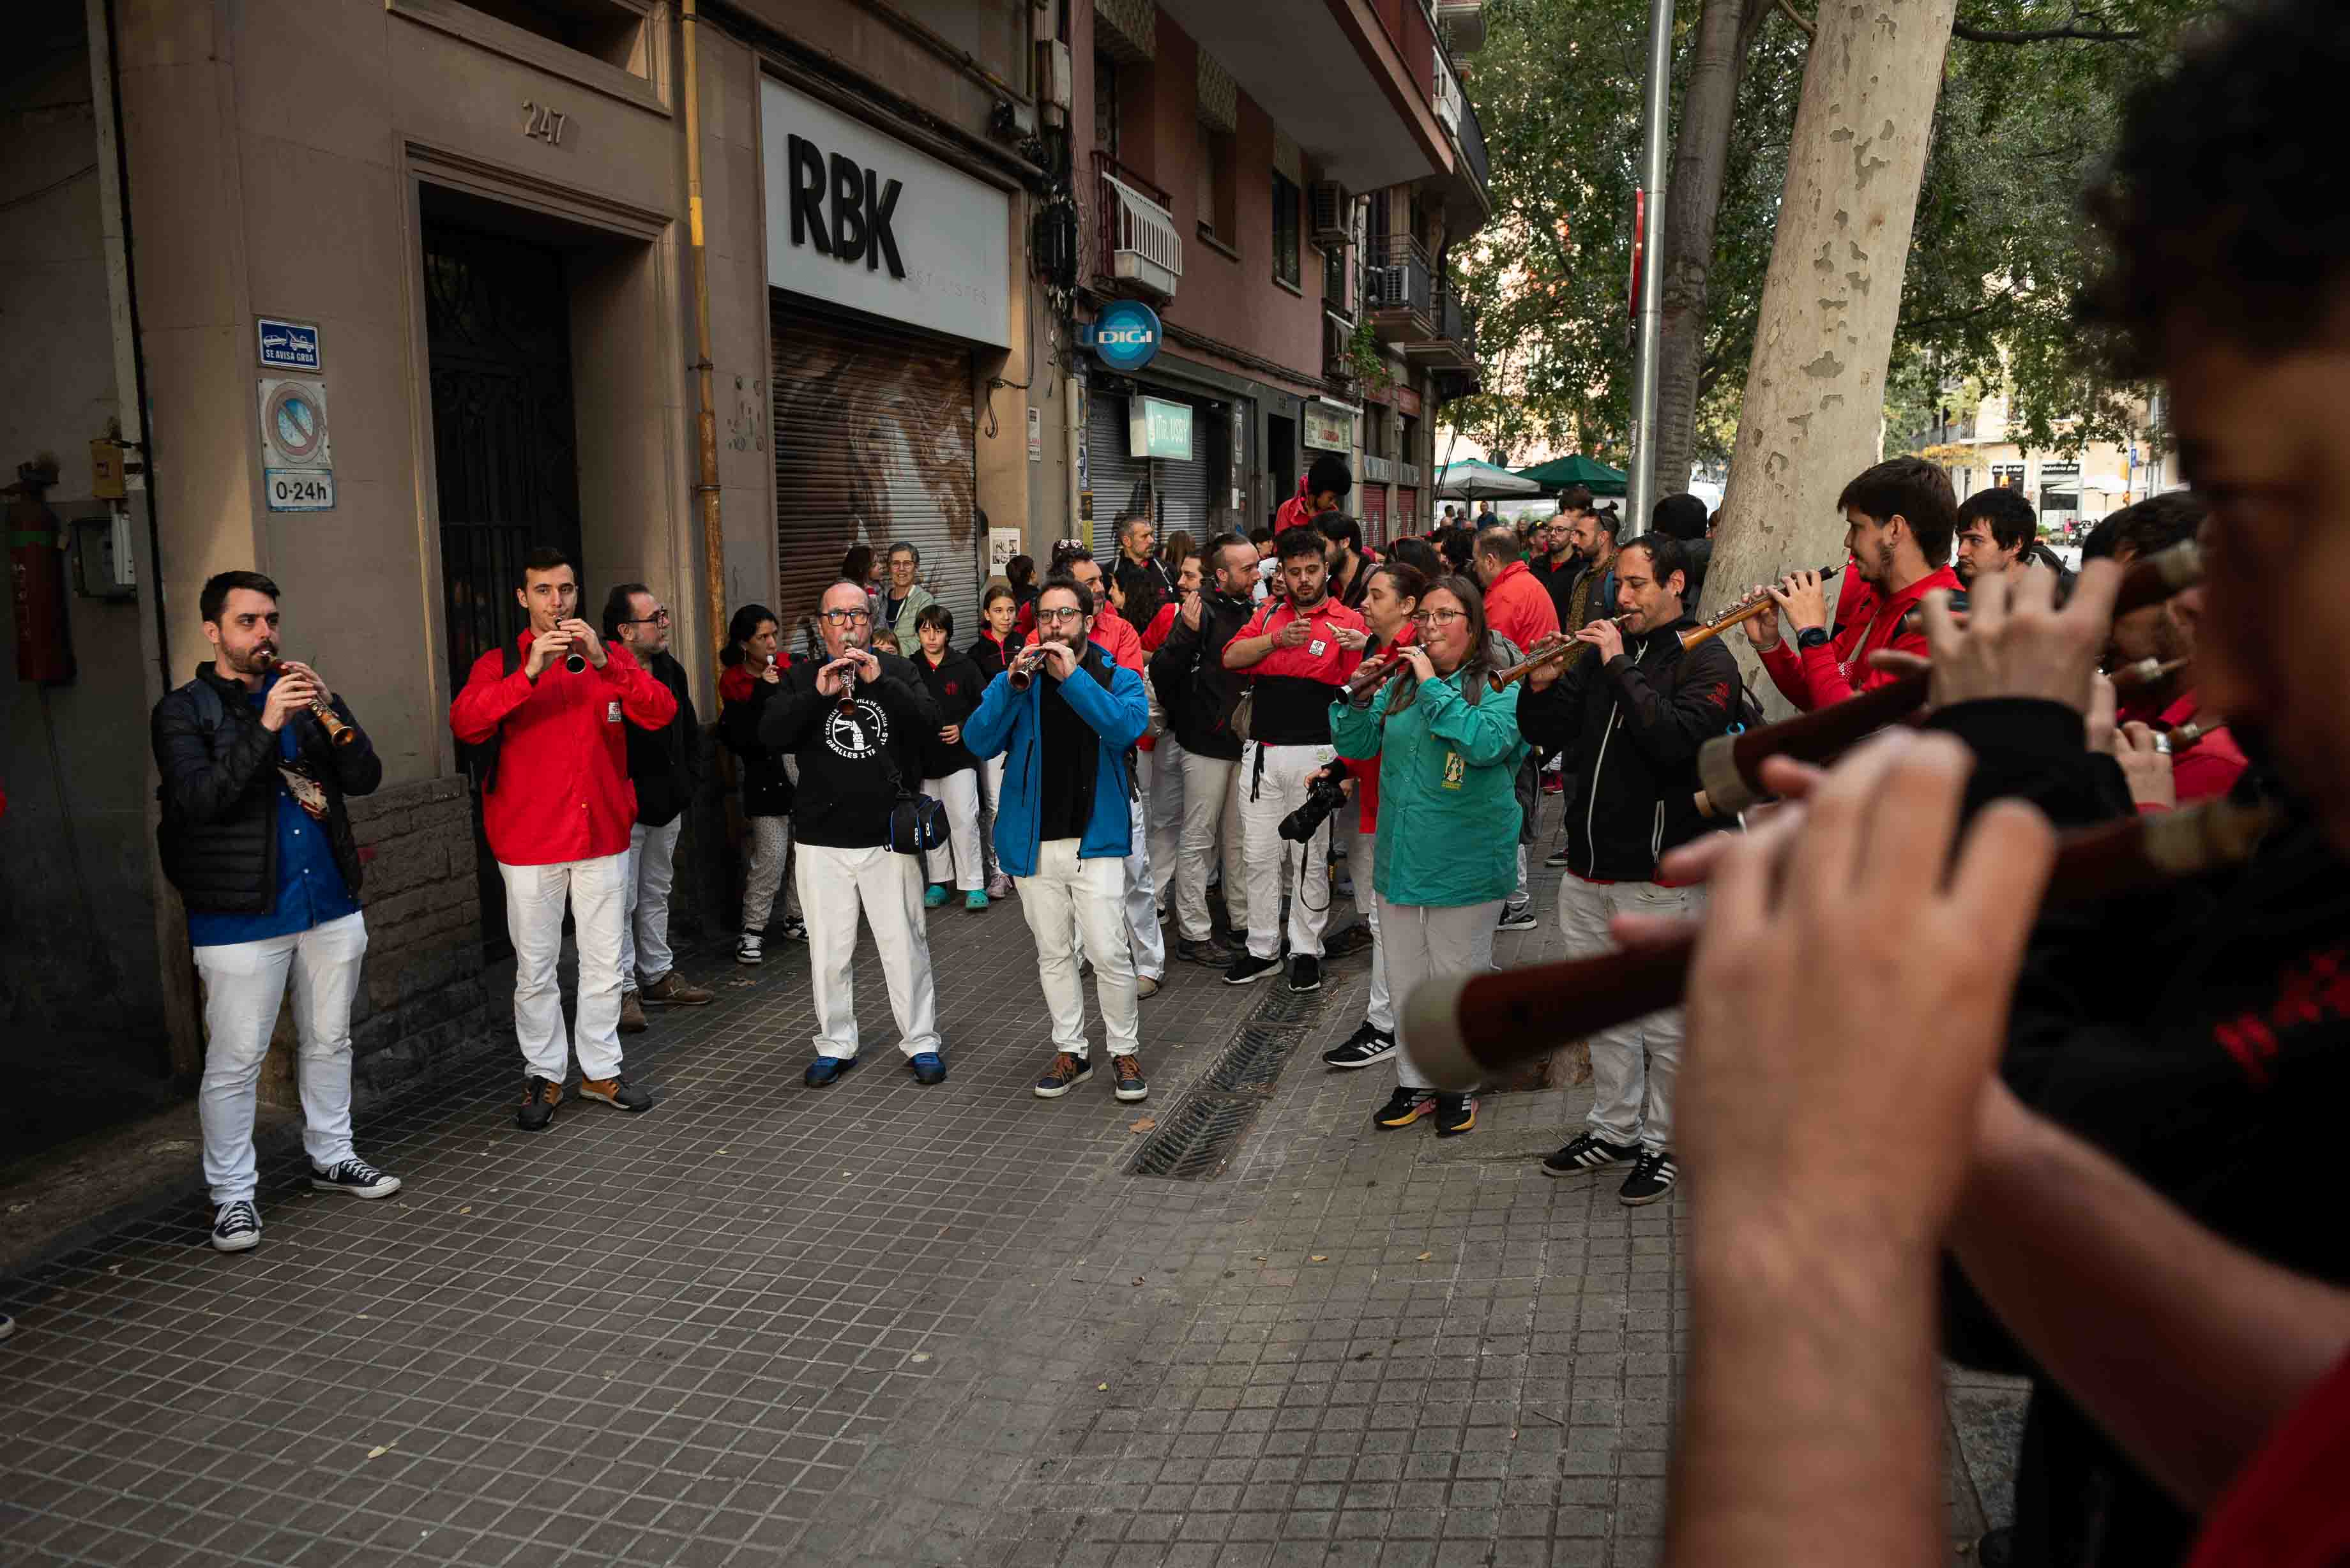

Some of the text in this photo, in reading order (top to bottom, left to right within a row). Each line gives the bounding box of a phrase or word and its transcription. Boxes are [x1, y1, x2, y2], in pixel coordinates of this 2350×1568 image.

[522, 100, 566, 144] 247
[787, 133, 906, 280] RBK
[1098, 331, 1153, 343] DIGI
[266, 349, 314, 363] SE AVISA GRUA
[276, 481, 327, 500] 0-24h
[825, 709, 840, 735] CASTELLE
[826, 739, 858, 758] GRALLES
